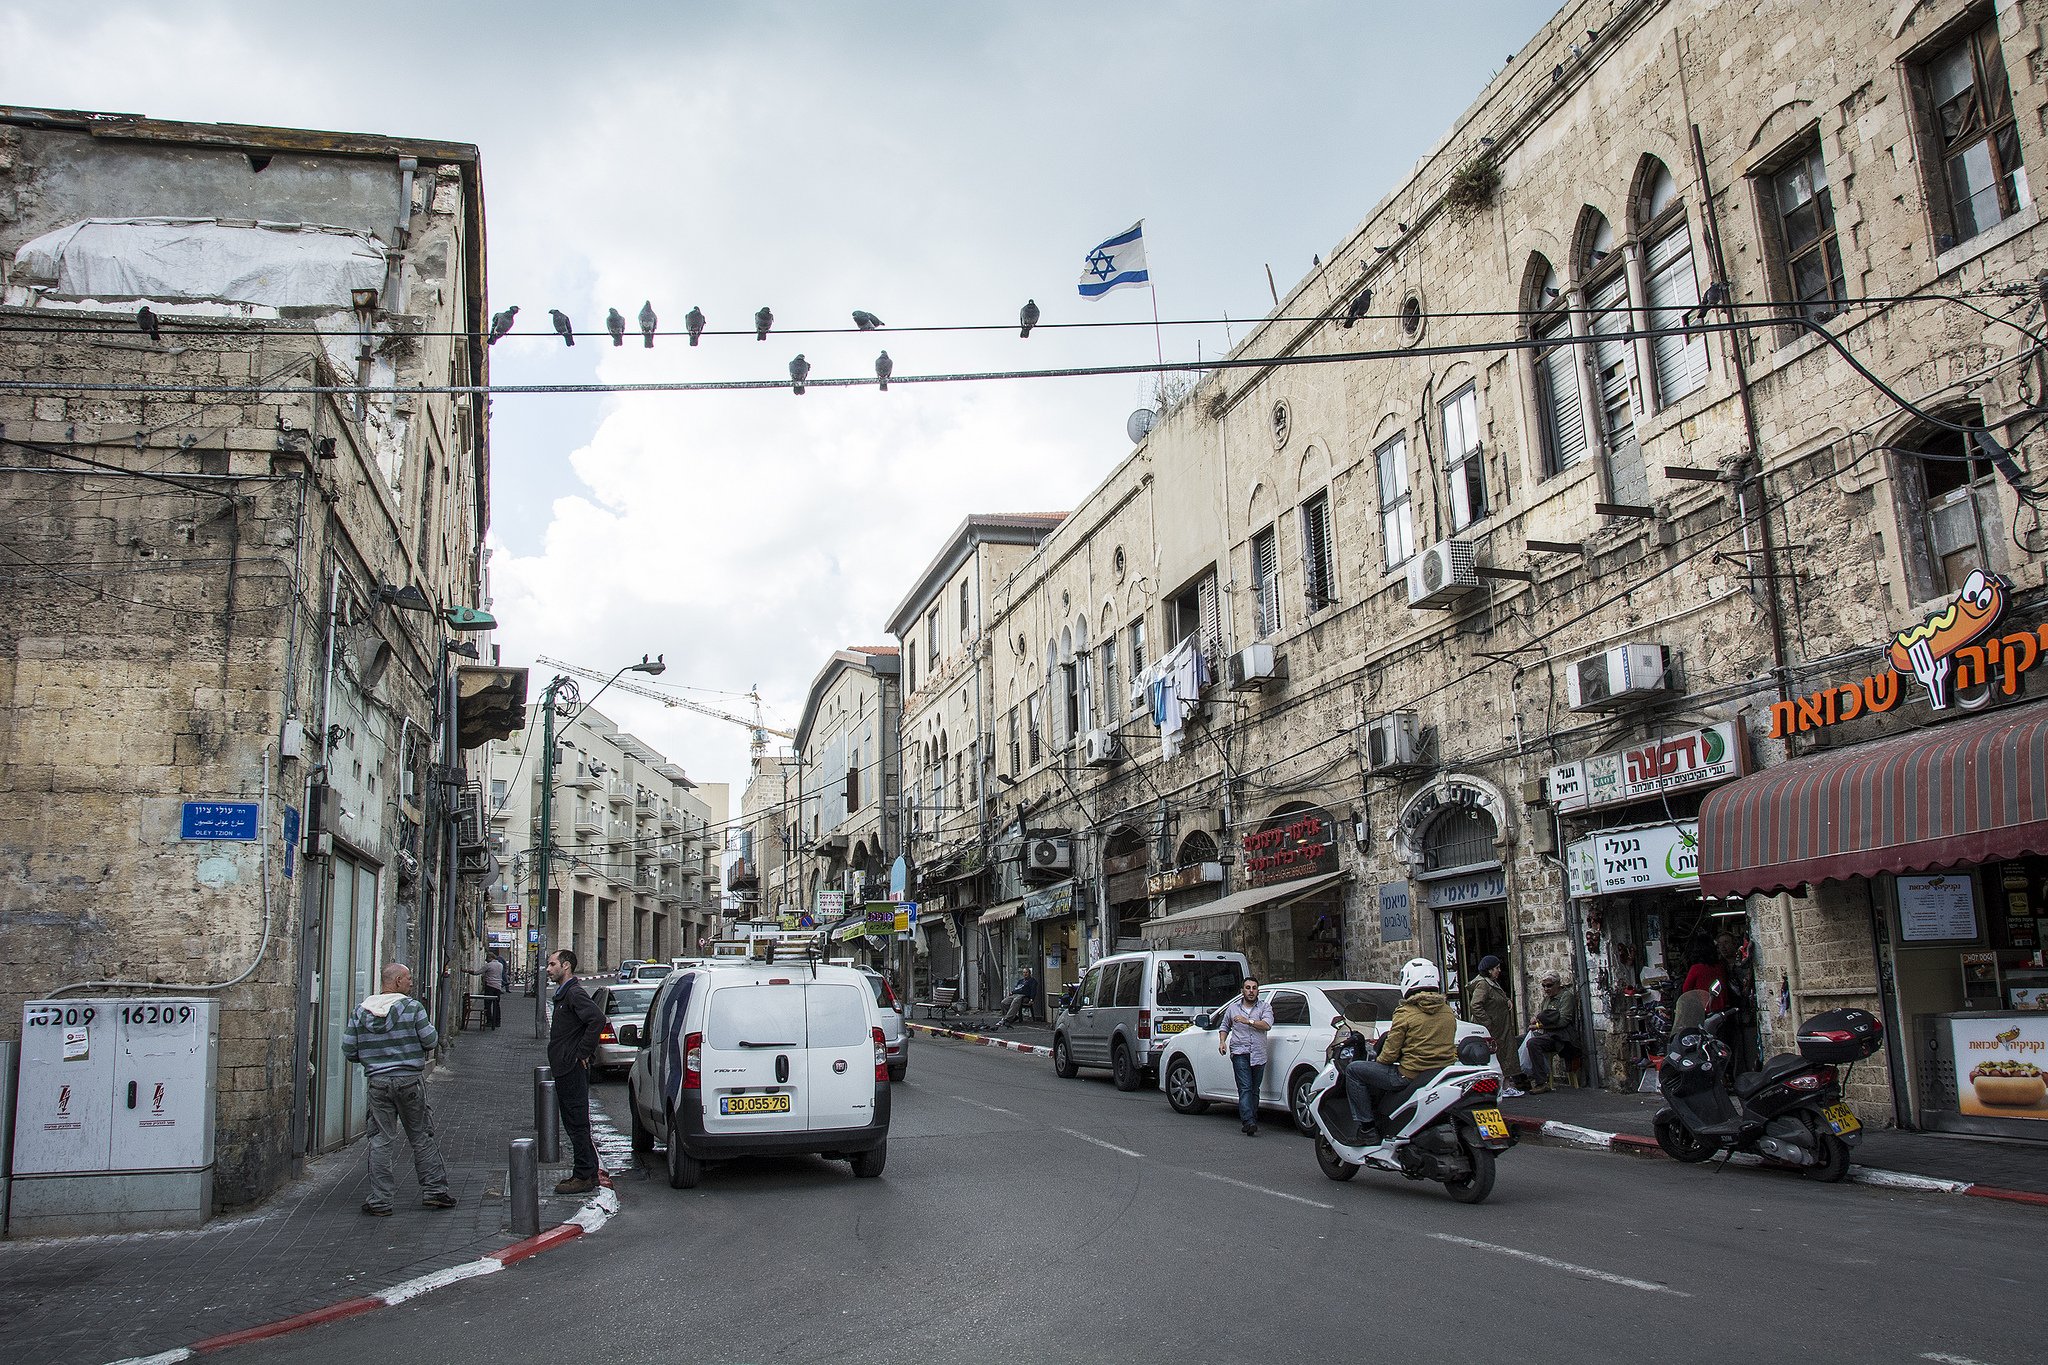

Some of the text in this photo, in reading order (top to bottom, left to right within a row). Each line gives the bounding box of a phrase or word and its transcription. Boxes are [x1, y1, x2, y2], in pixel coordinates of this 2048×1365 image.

[1768, 669, 1898, 739] שכזאת
[1626, 735, 1697, 782] דפנה
[1557, 768, 1575, 779] נעלי
[1708, 764, 1726, 775] נעלי
[1655, 777, 1673, 788] דפה
[1675, 770, 1708, 783] הקיבוצים
[1556, 781, 1578, 794] רויאל
[195, 806, 212, 815] ציון
[215, 806, 233, 815] עולי
[1604, 838, 1640, 855] נעלי
[1604, 856, 1648, 874] רויאל
[1605, 874, 1650, 886] נוסד 1955
[1444, 876, 1507, 902] עלי מיאמי
[1382, 894, 1407, 910] מיאמי
[1968, 953, 1993, 961] HOT DOGS
[28, 1007, 96, 1026] 16209
[122, 1006, 190, 1025] 16209
[1968, 1040, 2045, 1053] נקניקיה שכזאת
[1488, 1124, 1499, 1135] 53
[1838, 1118, 1850, 1129] 74
